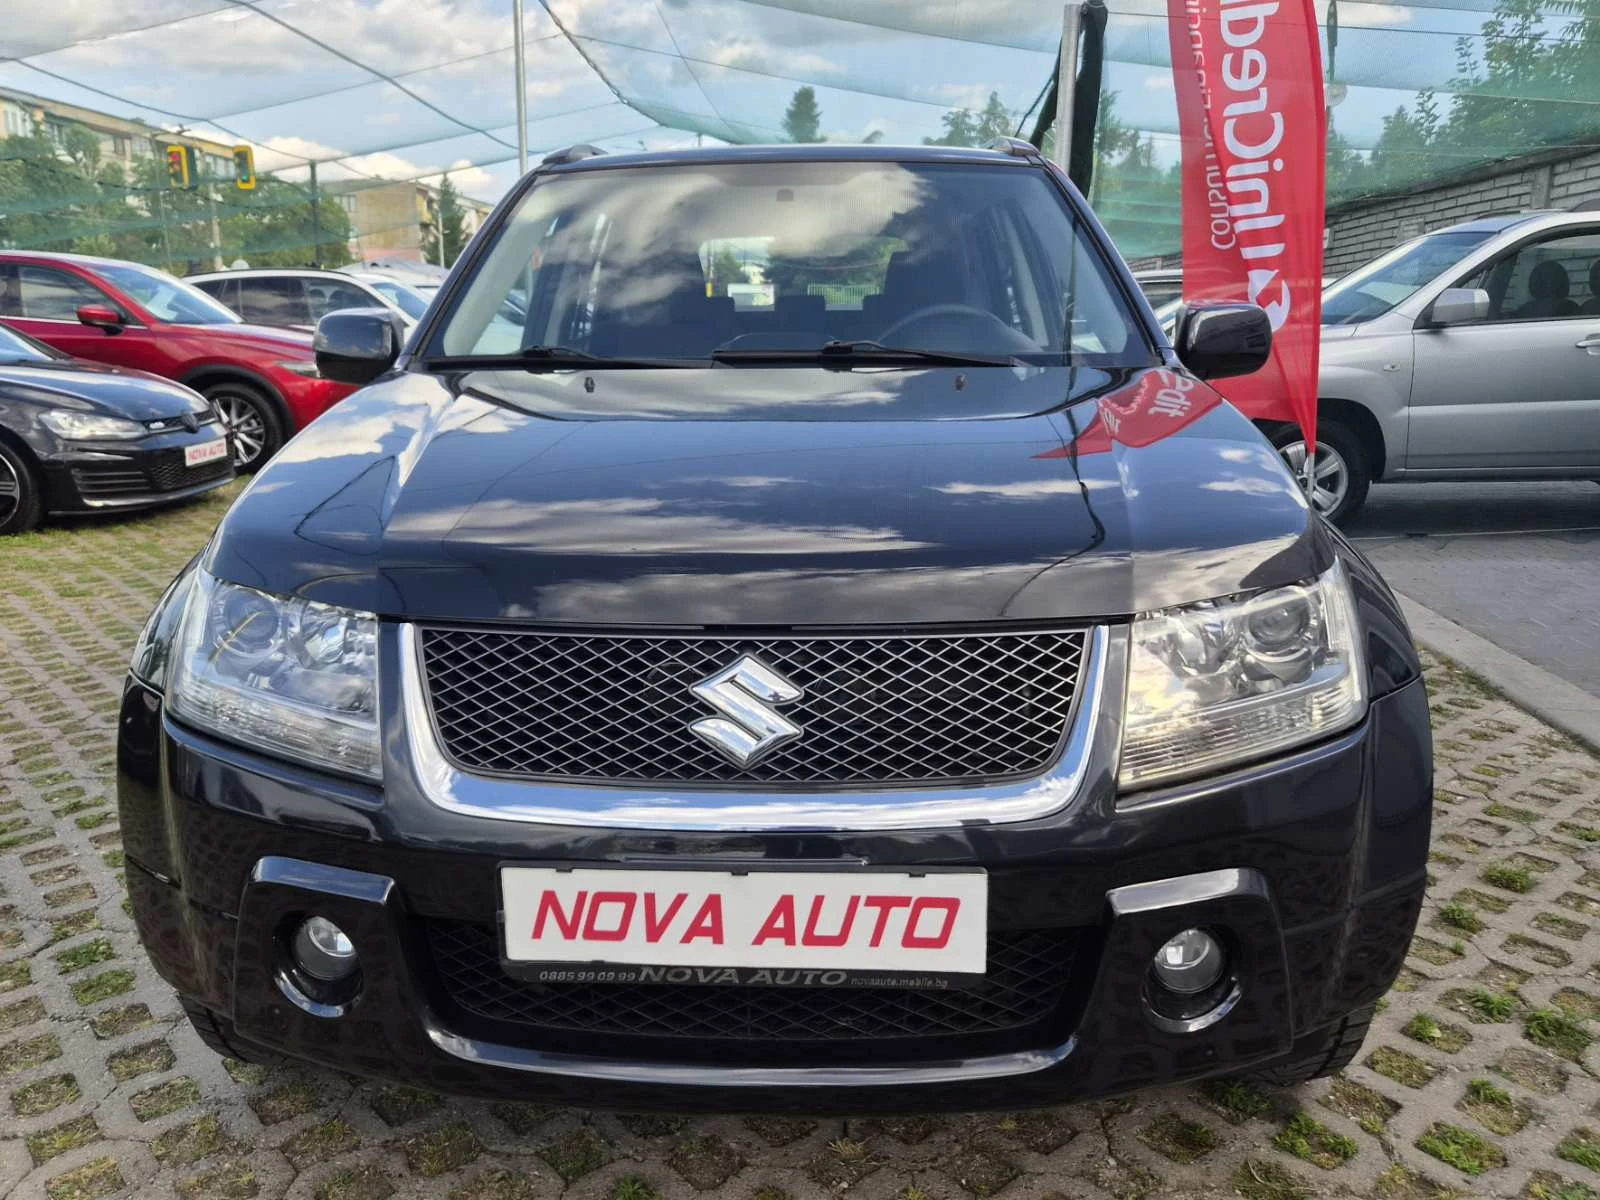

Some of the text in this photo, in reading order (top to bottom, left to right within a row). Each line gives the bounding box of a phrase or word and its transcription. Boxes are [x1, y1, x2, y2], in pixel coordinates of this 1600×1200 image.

[531, 890, 961, 949] NOVA AUTO
[638, 967, 739, 984] NOVA
[746, 969, 848, 986] AUTO
